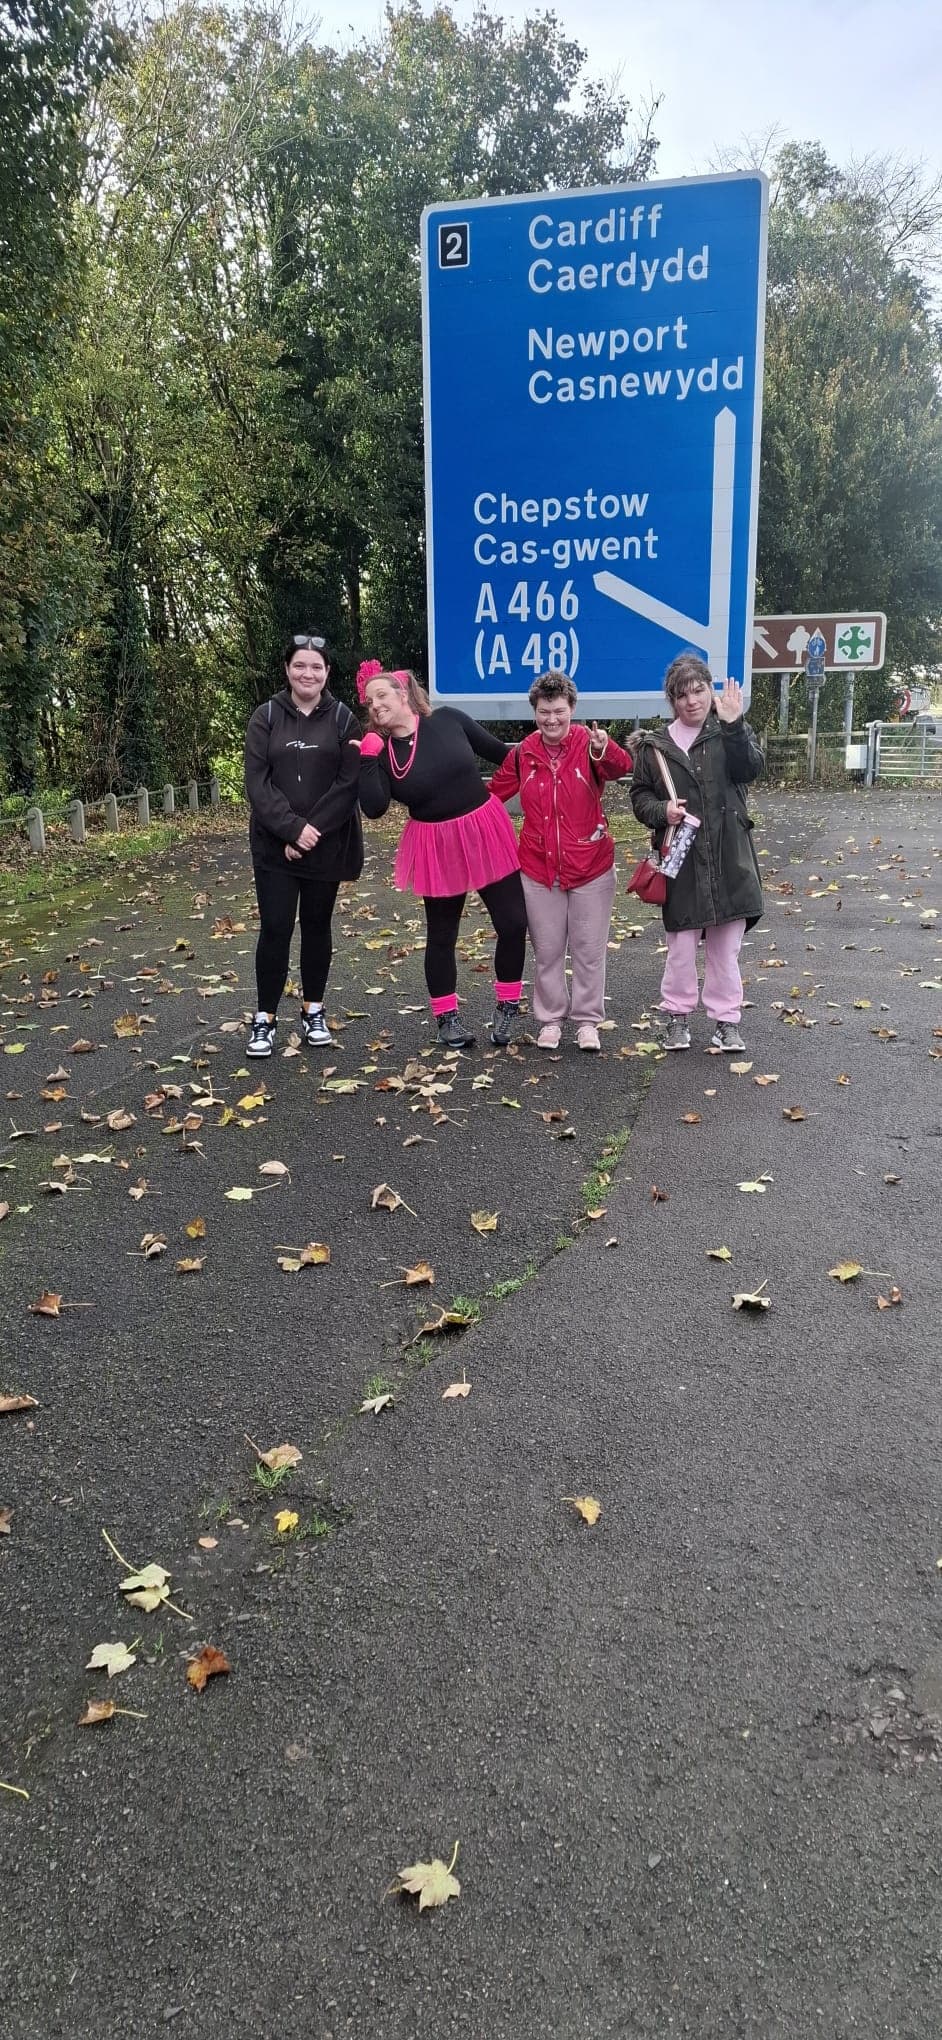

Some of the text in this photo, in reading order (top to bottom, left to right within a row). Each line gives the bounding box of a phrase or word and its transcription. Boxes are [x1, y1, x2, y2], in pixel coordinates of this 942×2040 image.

[445, 232, 462, 260] 2
[528, 203, 663, 250] Cardiff
[528, 245, 709, 293] Caerdydd
[528, 316, 688, 361] Newport
[528, 356, 744, 404] Casnewydd
[474, 488, 649, 527] Chepstow
[474, 528, 658, 569] Cas-gwent
